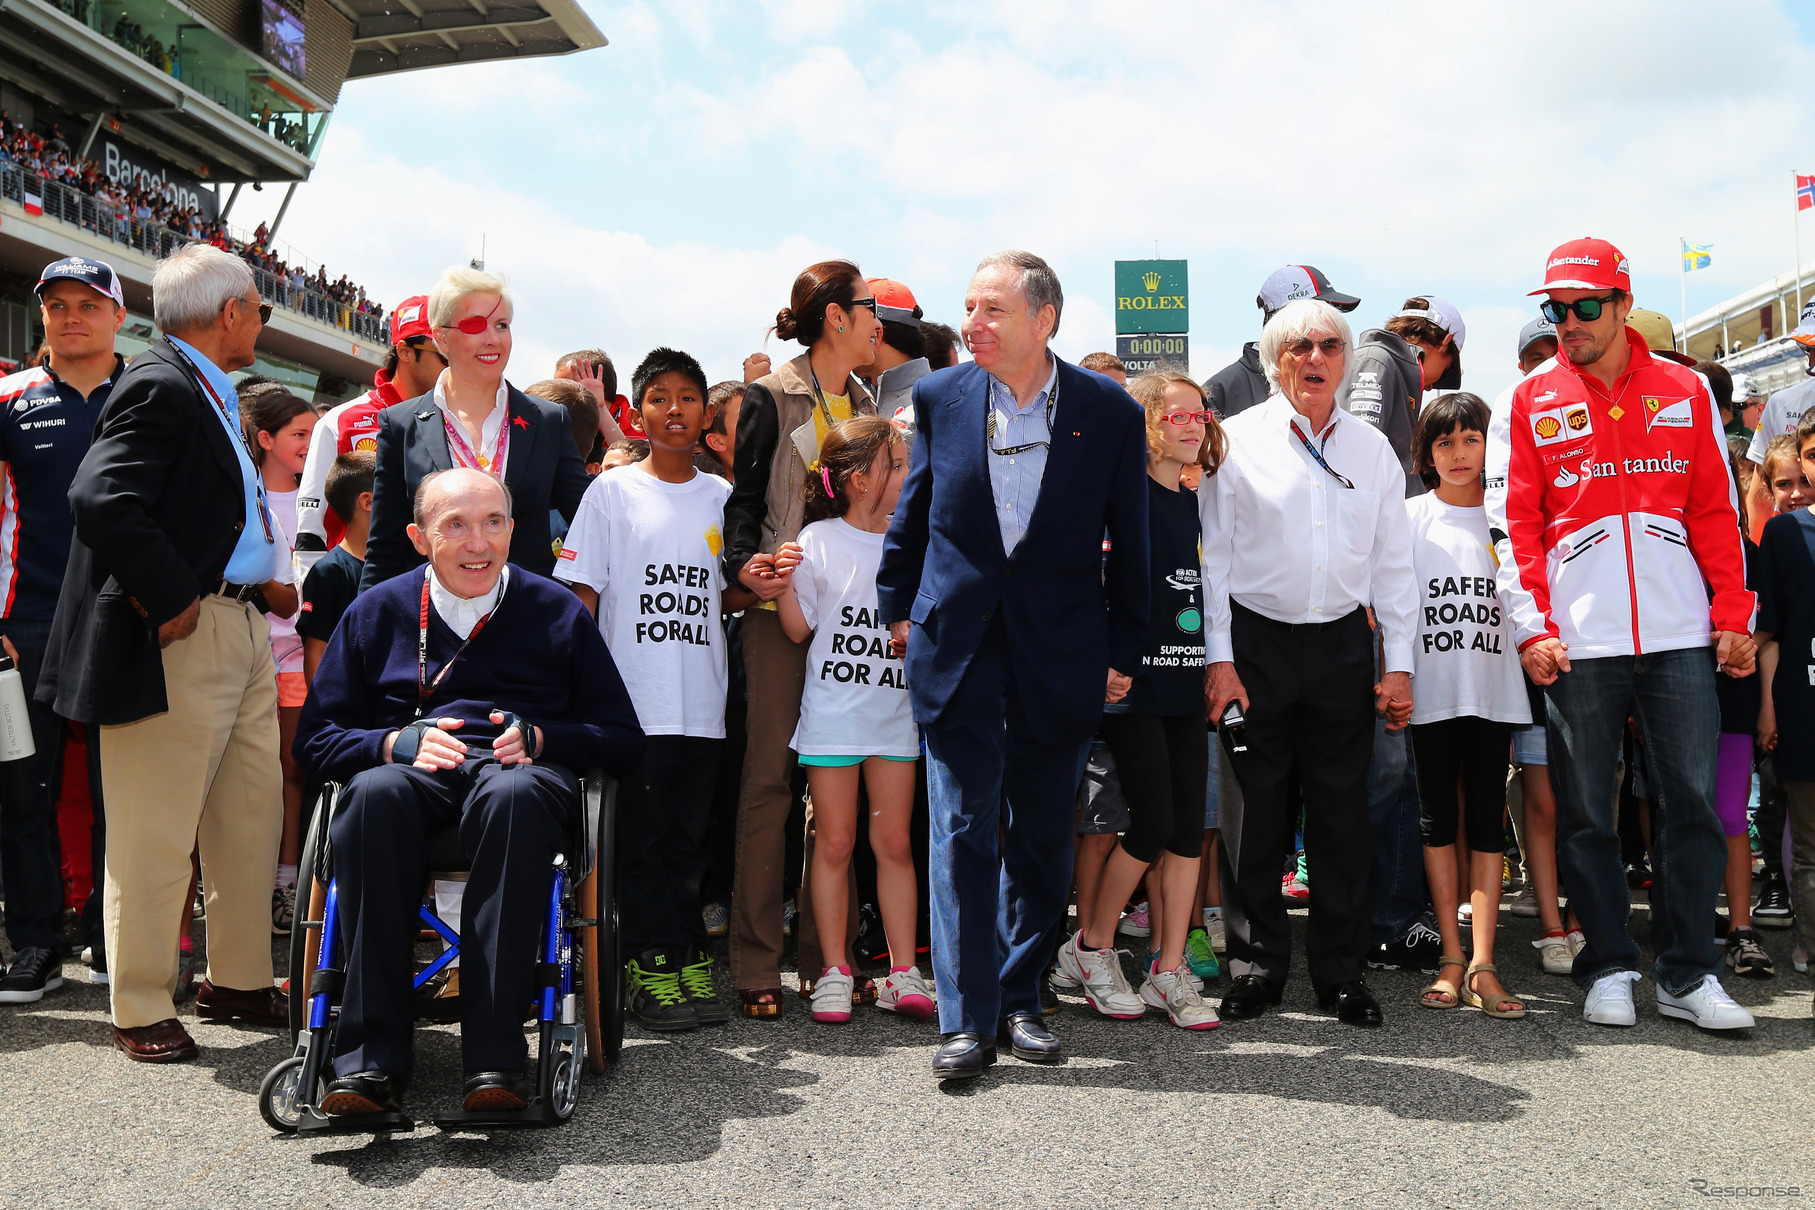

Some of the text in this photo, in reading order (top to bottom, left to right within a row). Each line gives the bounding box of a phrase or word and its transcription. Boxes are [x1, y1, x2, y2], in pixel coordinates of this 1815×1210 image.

[1552, 255, 1600, 267] Santander
[54, 263, 99, 275] WILLIAMS
[1287, 290, 1310, 301] DEKRA
[1117, 295, 1187, 310] ROLEX
[1351, 382, 1383, 390] TELMEX
[29, 395, 62, 407] PDVSA
[1534, 394, 1555, 403] PUMA
[33, 418, 66, 429] WIHURI
[353, 419, 373, 428] PUMA
[1569, 413, 1587, 429] ups
[1559, 448, 1584, 460] ALONSO
[644, 563, 711, 590] SAFER
[1428, 576, 1497, 600] SAFER
[1189, 594, 1195, 603] &
[639, 592, 711, 619] ROADS
[1424, 602, 1501, 627] ROADS
[831, 633, 899, 661] ROAD
[1422, 629, 1502, 655] FOR ALL
[419, 650, 427, 664] PIT
[1152, 656, 1180, 667] ROAD
[1182, 657, 1205, 667] SAFE
[820, 660, 871, 686] FOR
